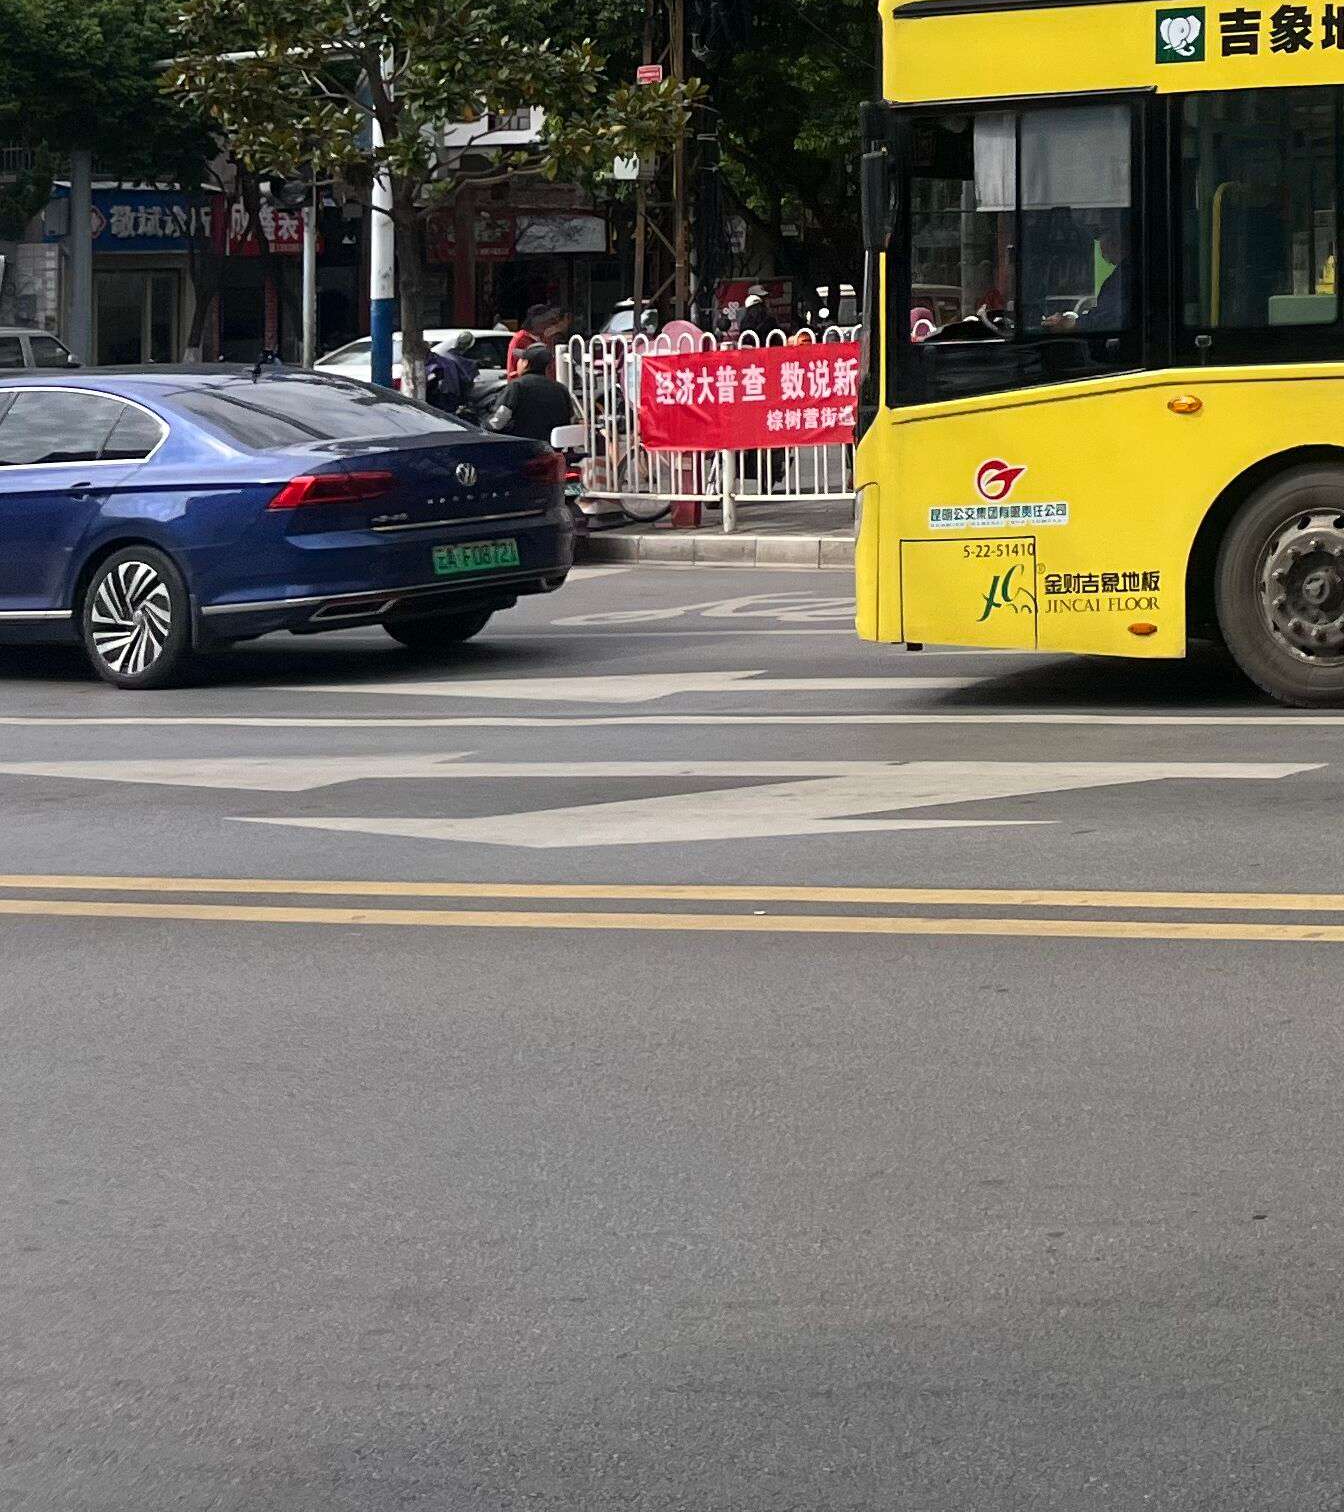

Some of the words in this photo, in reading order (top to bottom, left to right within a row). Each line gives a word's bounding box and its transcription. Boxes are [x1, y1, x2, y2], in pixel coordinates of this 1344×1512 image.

[655, 364, 767, 406] 经济大普查
[780, 357, 858, 401] 数说新
[963, 543, 1035, 558] 5-22-51410
[1044, 570, 1161, 595] 金财吉象地板
[1045, 598, 1101, 614] JINCAI
[1107, 595, 1161, 612] FLOOR
